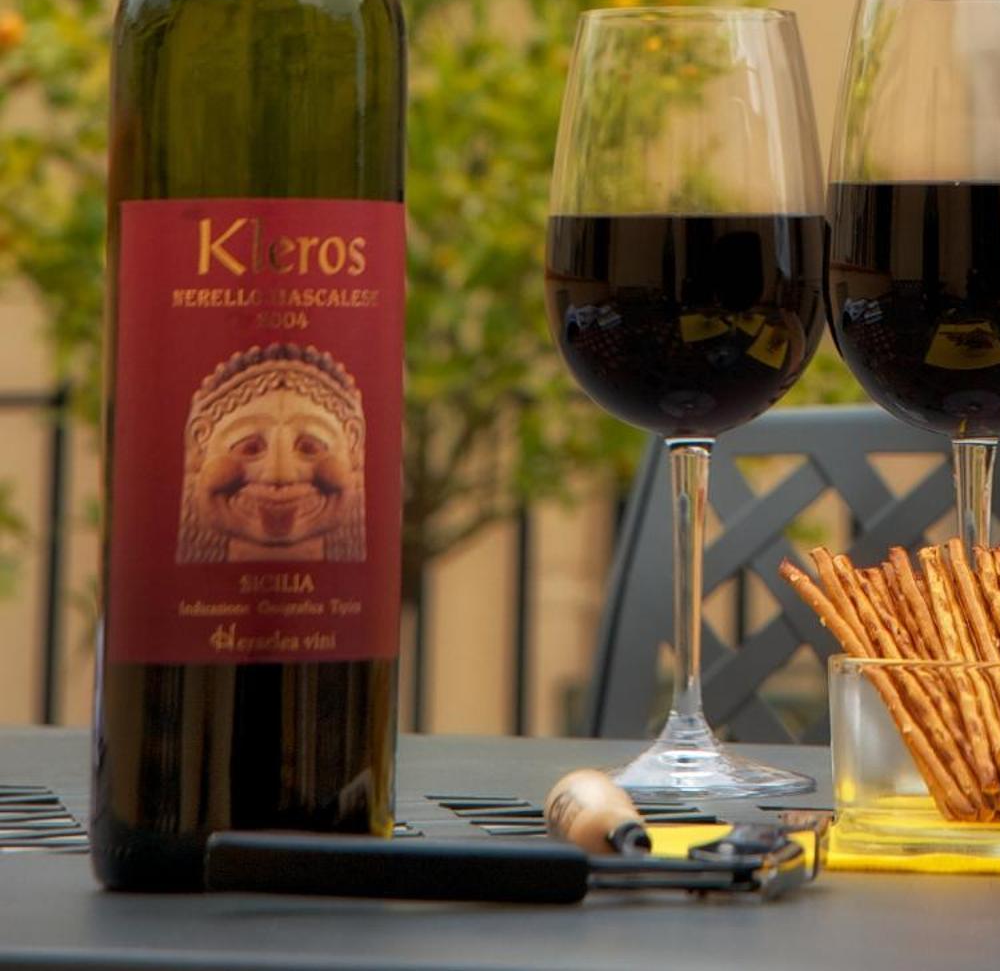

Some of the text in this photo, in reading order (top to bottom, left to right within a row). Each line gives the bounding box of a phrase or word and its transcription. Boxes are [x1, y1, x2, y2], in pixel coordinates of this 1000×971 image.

[197, 217, 367, 276] Kleros
[171, 288, 262, 307] NERELLO
[239, 573, 316, 594] SICILIA
